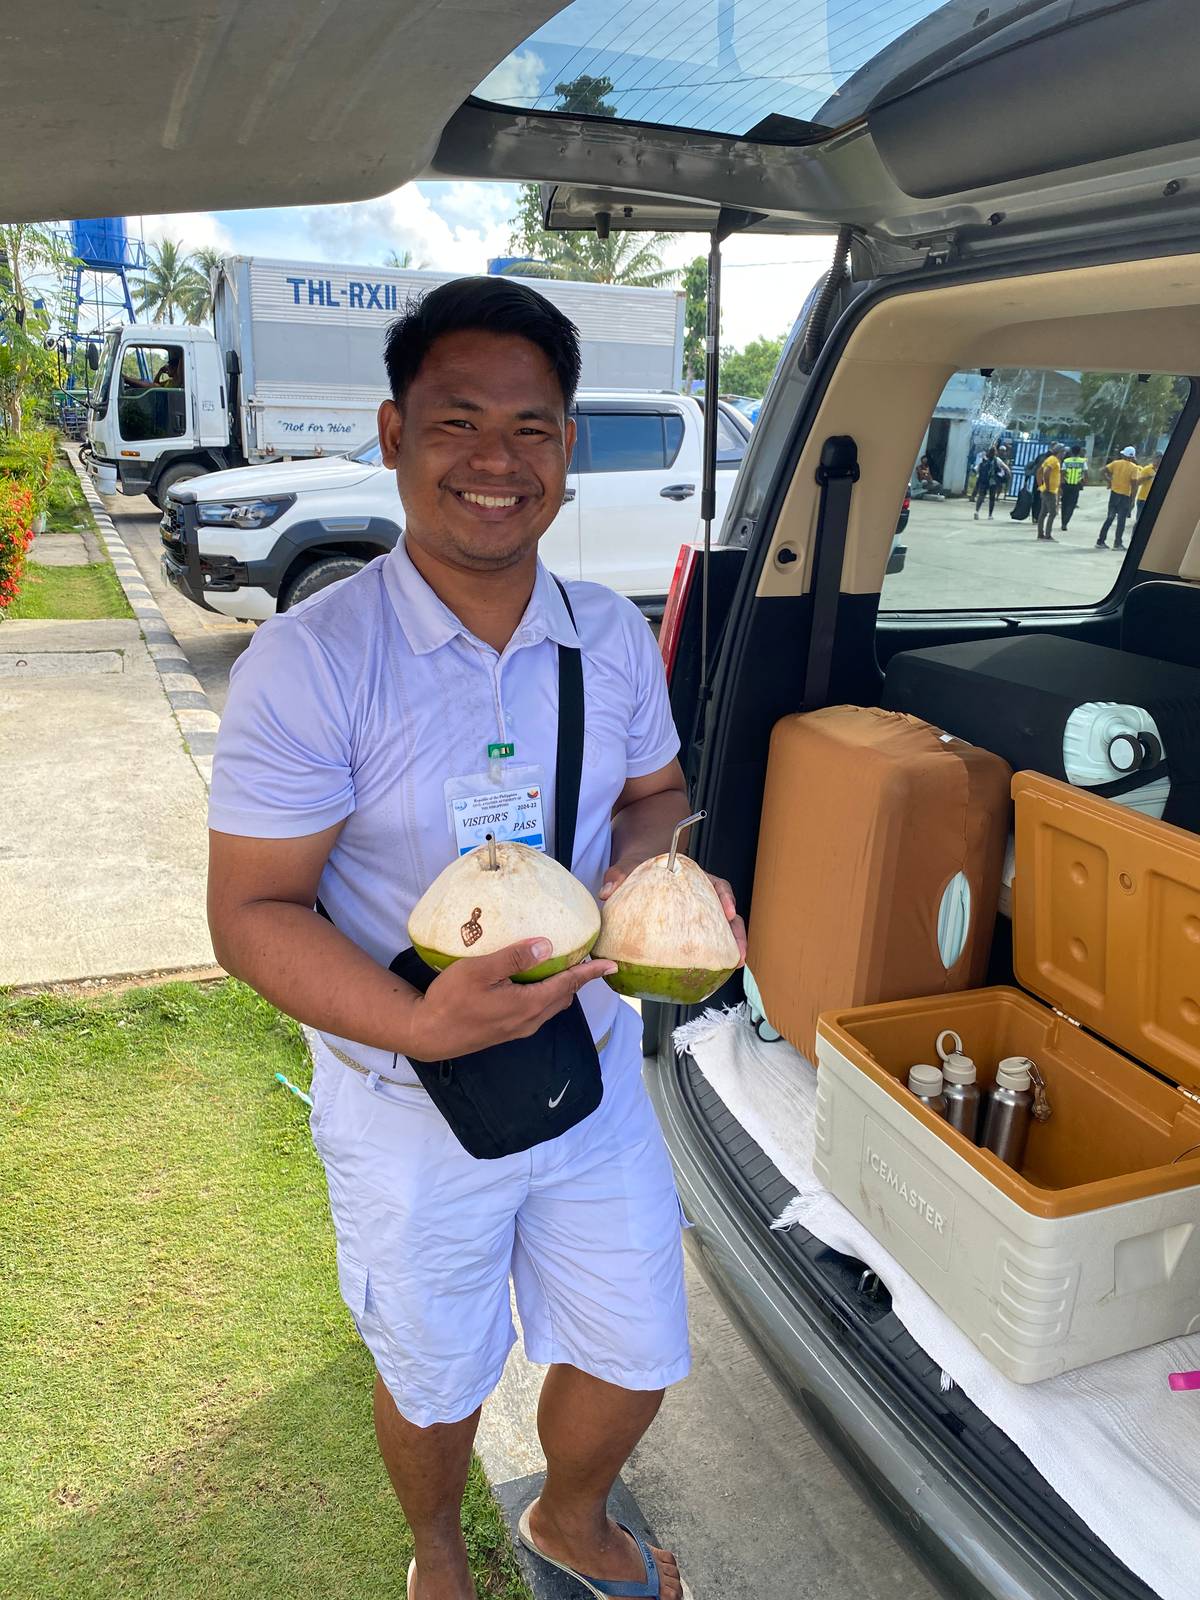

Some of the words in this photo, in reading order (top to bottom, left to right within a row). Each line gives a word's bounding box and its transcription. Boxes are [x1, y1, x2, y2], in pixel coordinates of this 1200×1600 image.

[286, 278, 397, 310] THL-RXII
[462, 811, 508, 828] VISITOR'S
[513, 819, 537, 832] PASS
[865, 1145, 944, 1235] ICEMASTER
